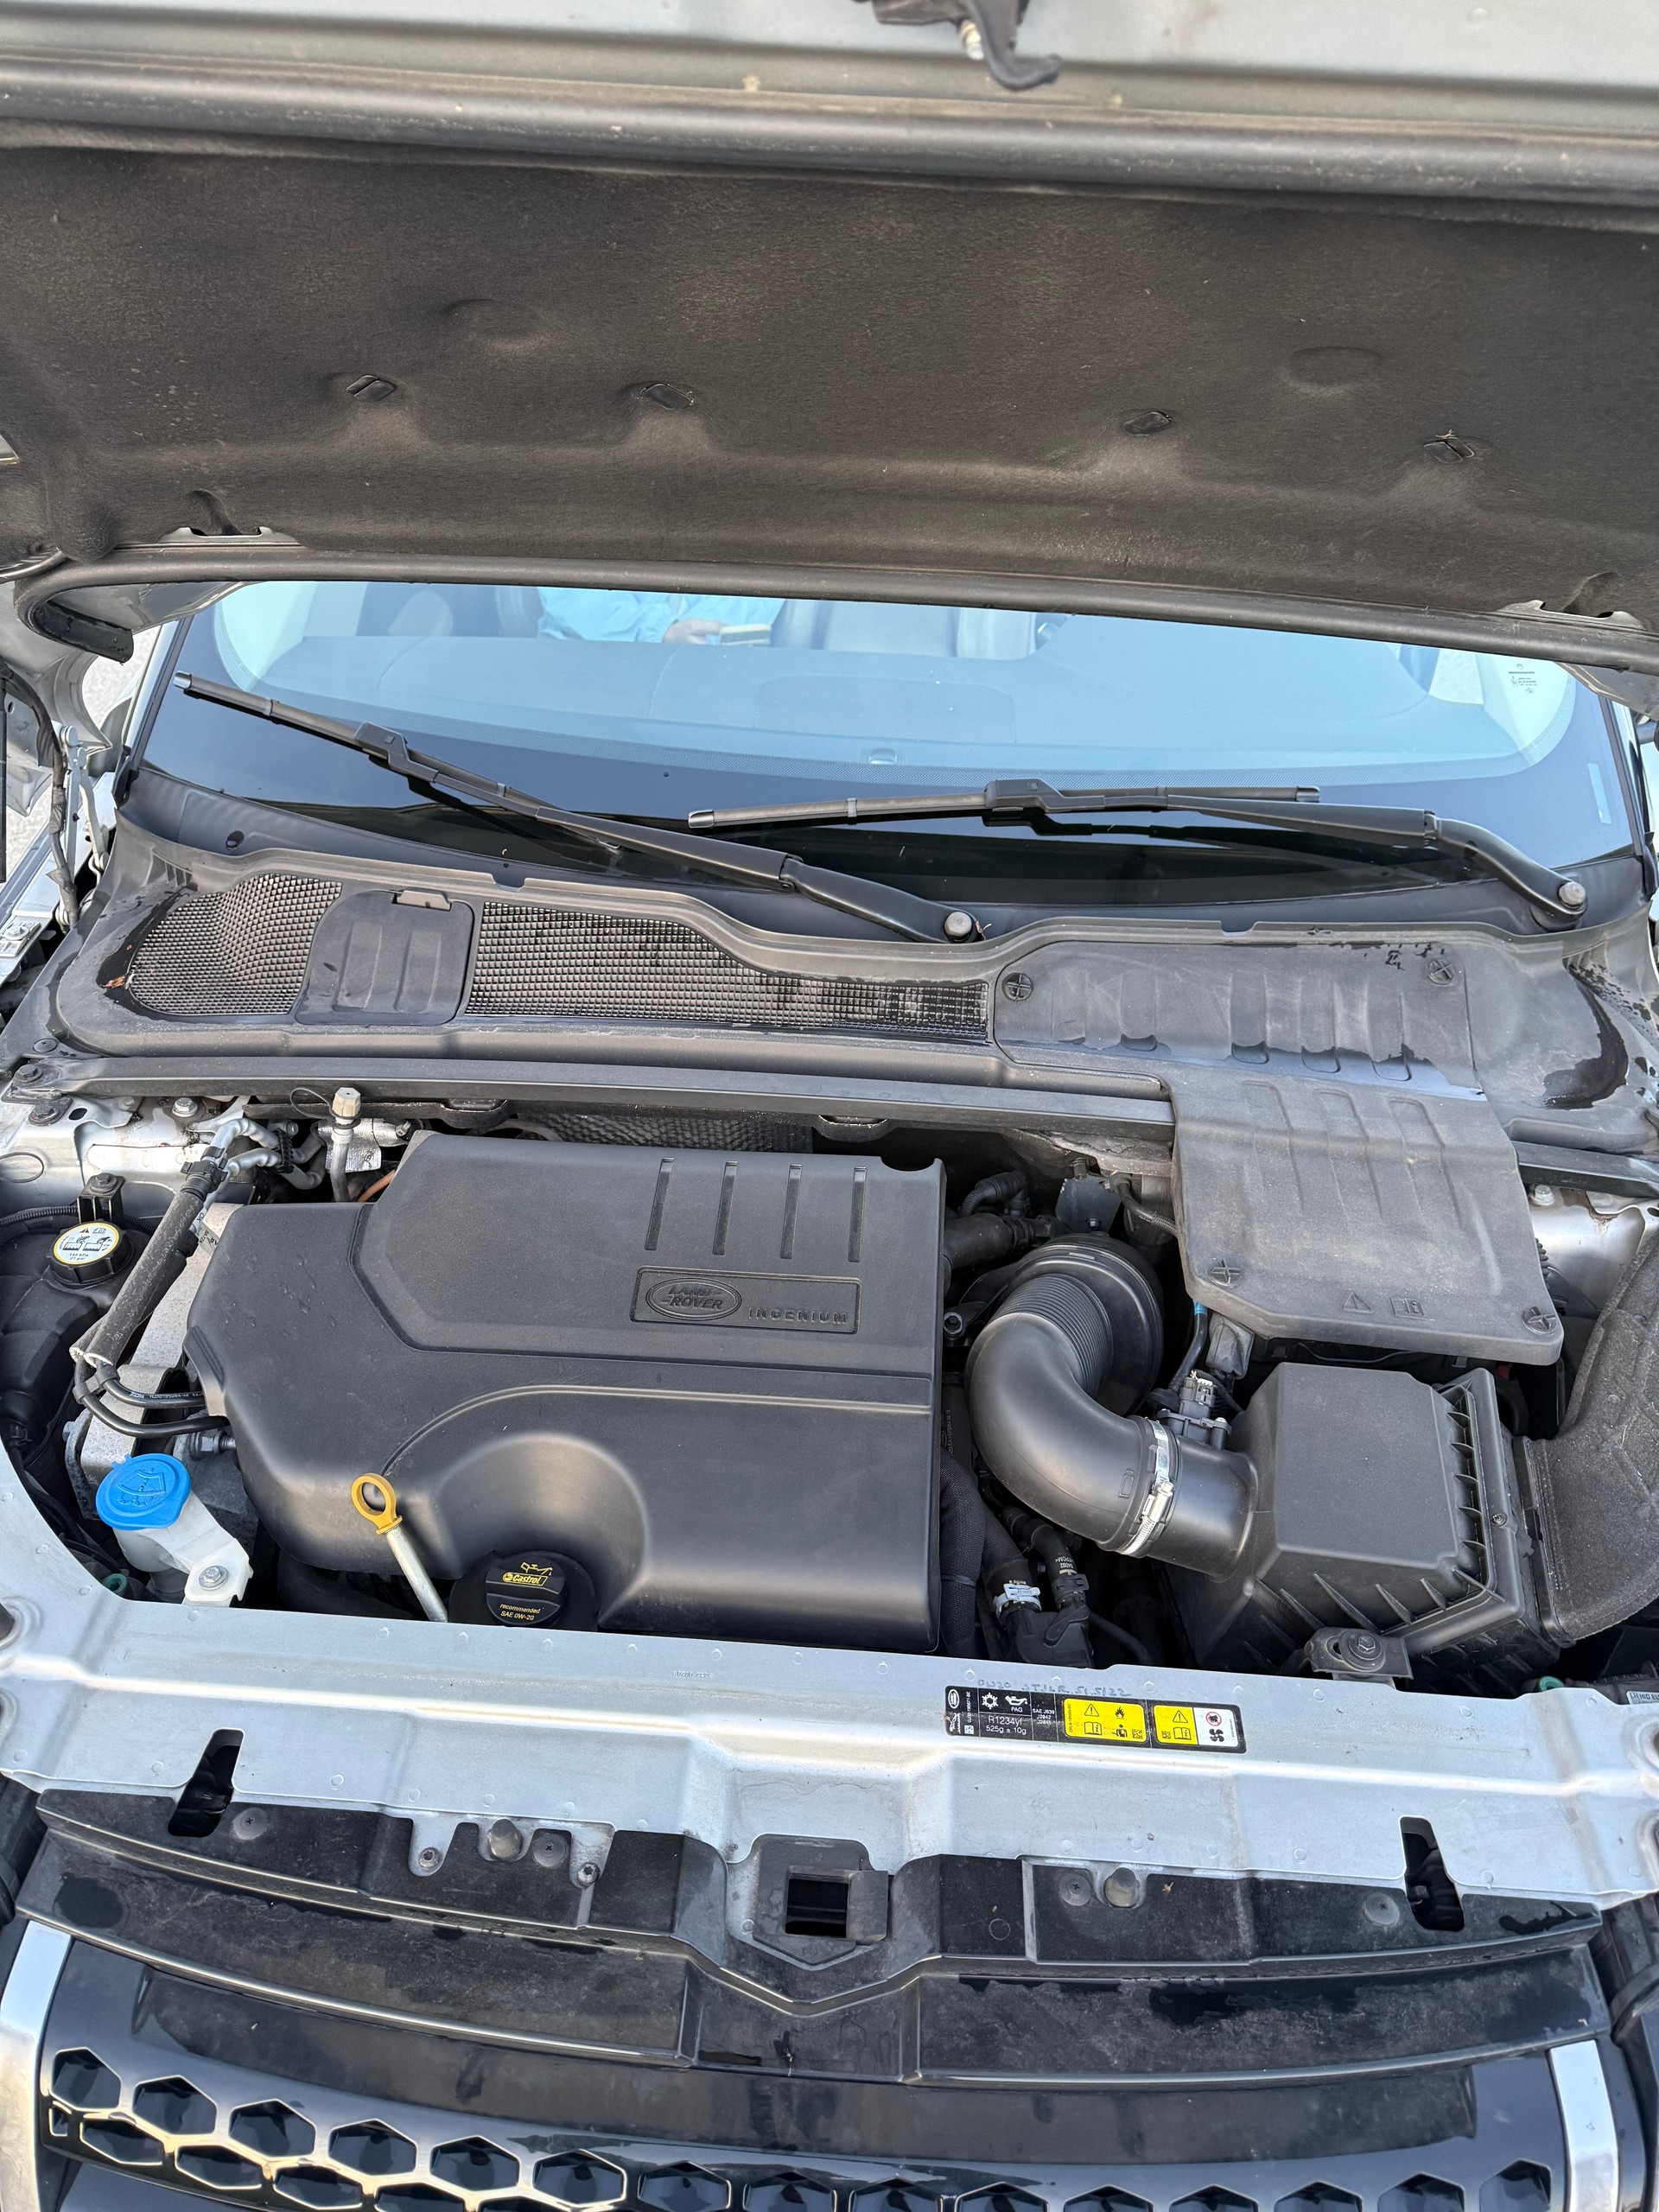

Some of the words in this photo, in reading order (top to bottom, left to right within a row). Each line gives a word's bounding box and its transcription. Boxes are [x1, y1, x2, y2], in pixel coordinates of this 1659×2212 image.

[668, 1286, 709, 1296] LAND
[670, 1297, 723, 1310] ROVER
[748, 1307, 848, 1325] INGENIUM
[512, 1573, 541, 1585] Castrol
[500, 1604, 541, 1614] recommended
[514, 1612, 535, 1621] 0W-20
[988, 1715, 1022, 1726] R1234yf
[986, 1725, 1004, 1734] 525g
